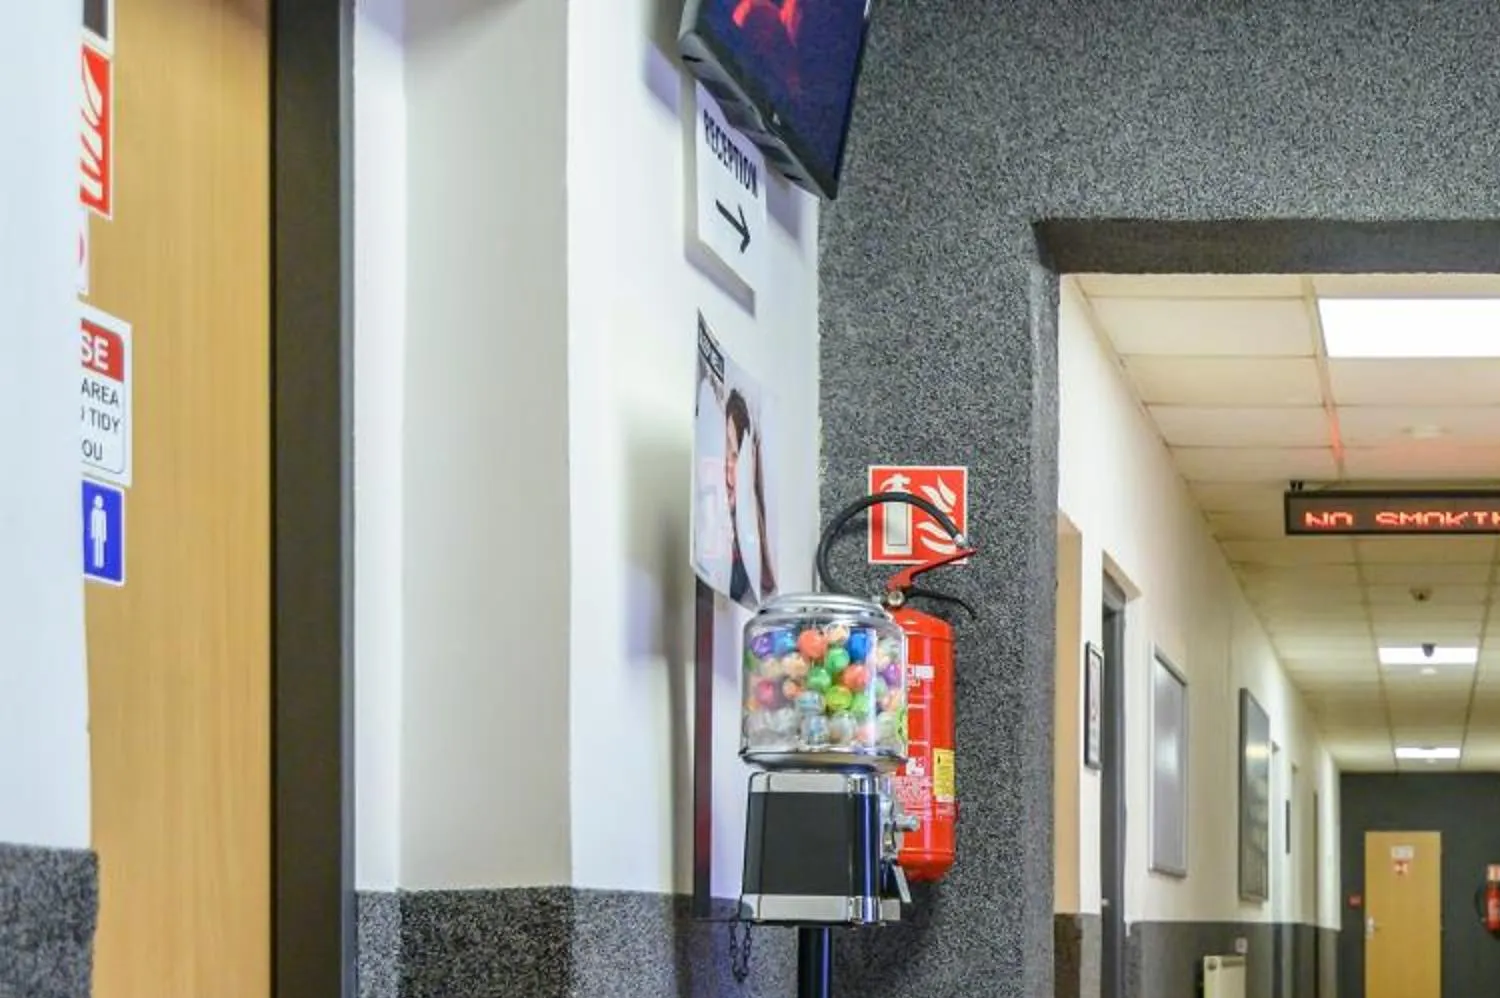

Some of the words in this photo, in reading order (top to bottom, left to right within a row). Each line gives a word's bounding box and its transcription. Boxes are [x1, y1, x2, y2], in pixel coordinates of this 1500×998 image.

[703, 108, 758, 199] RECEPTION
[81, 377, 119, 407] AREA
[89, 407, 121, 433] TIDY
[1305, 511, 1353, 527] NO
